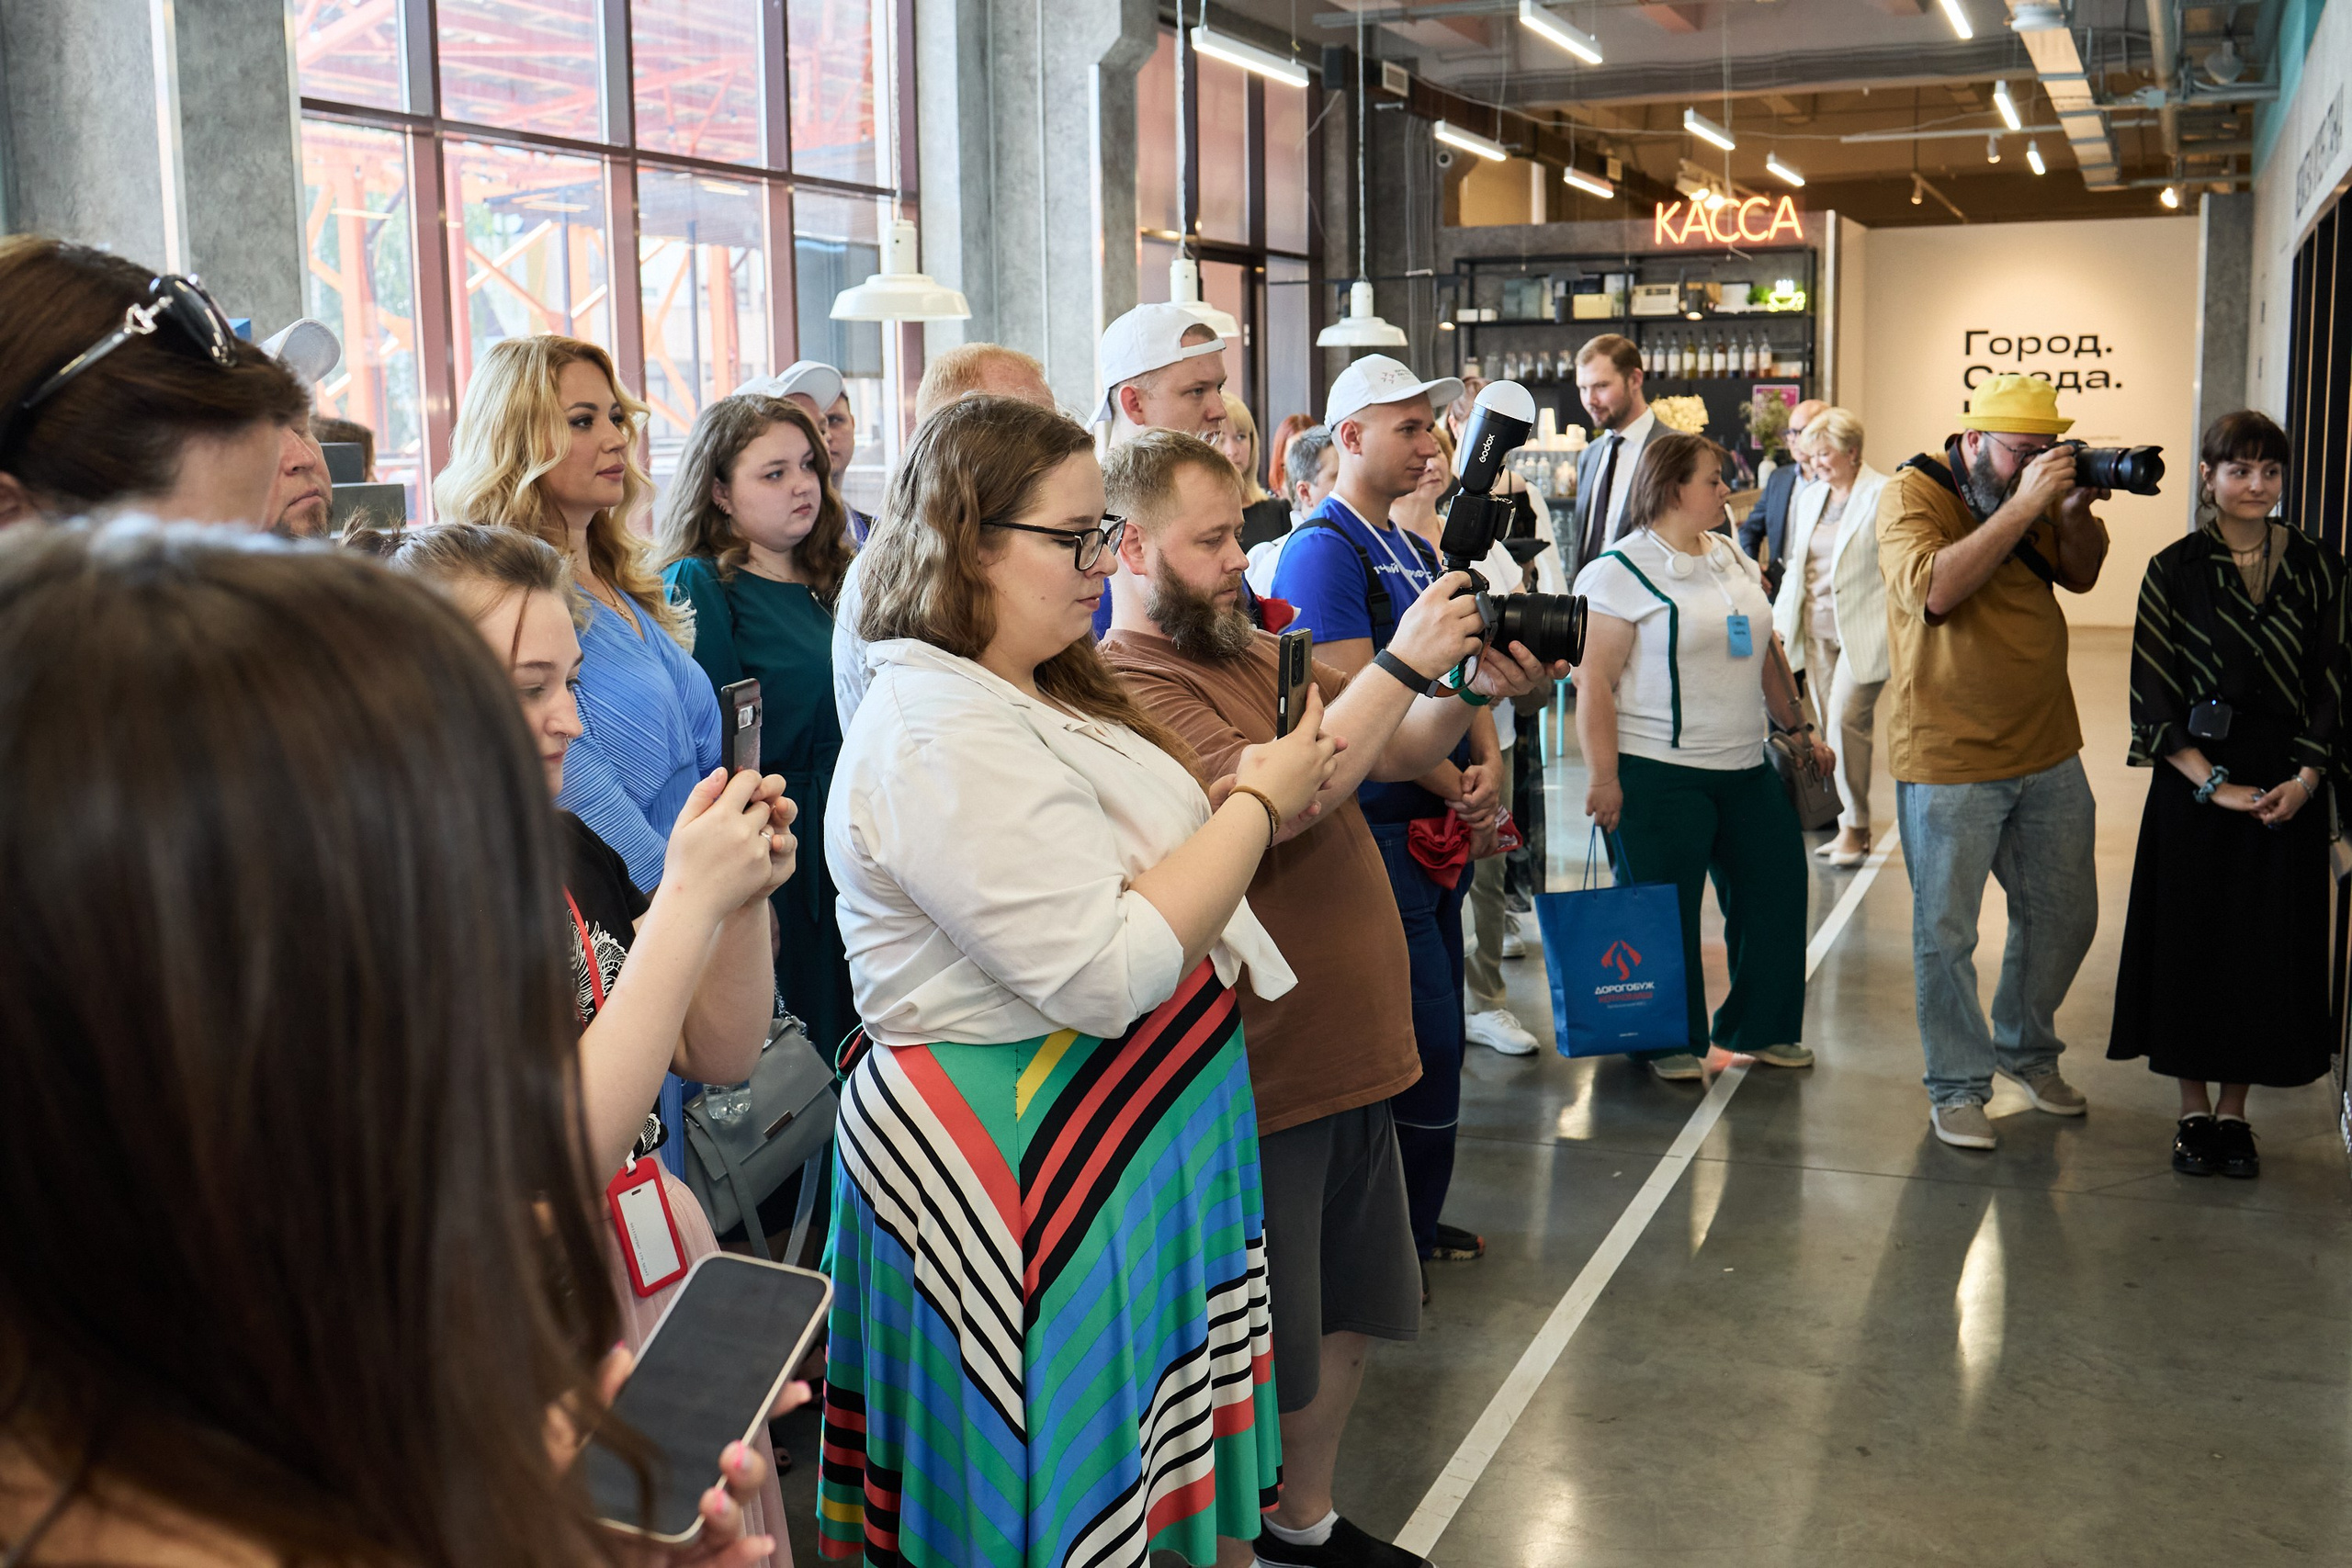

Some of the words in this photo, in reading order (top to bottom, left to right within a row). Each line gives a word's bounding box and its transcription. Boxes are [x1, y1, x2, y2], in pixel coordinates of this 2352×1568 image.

[1656, 195, 1803, 244] КАССА
[1965, 330, 2112, 362] Город.
[1478, 433, 1496, 463] Godox
[1594, 981, 1655, 995] ДОРОГОБУЖ
